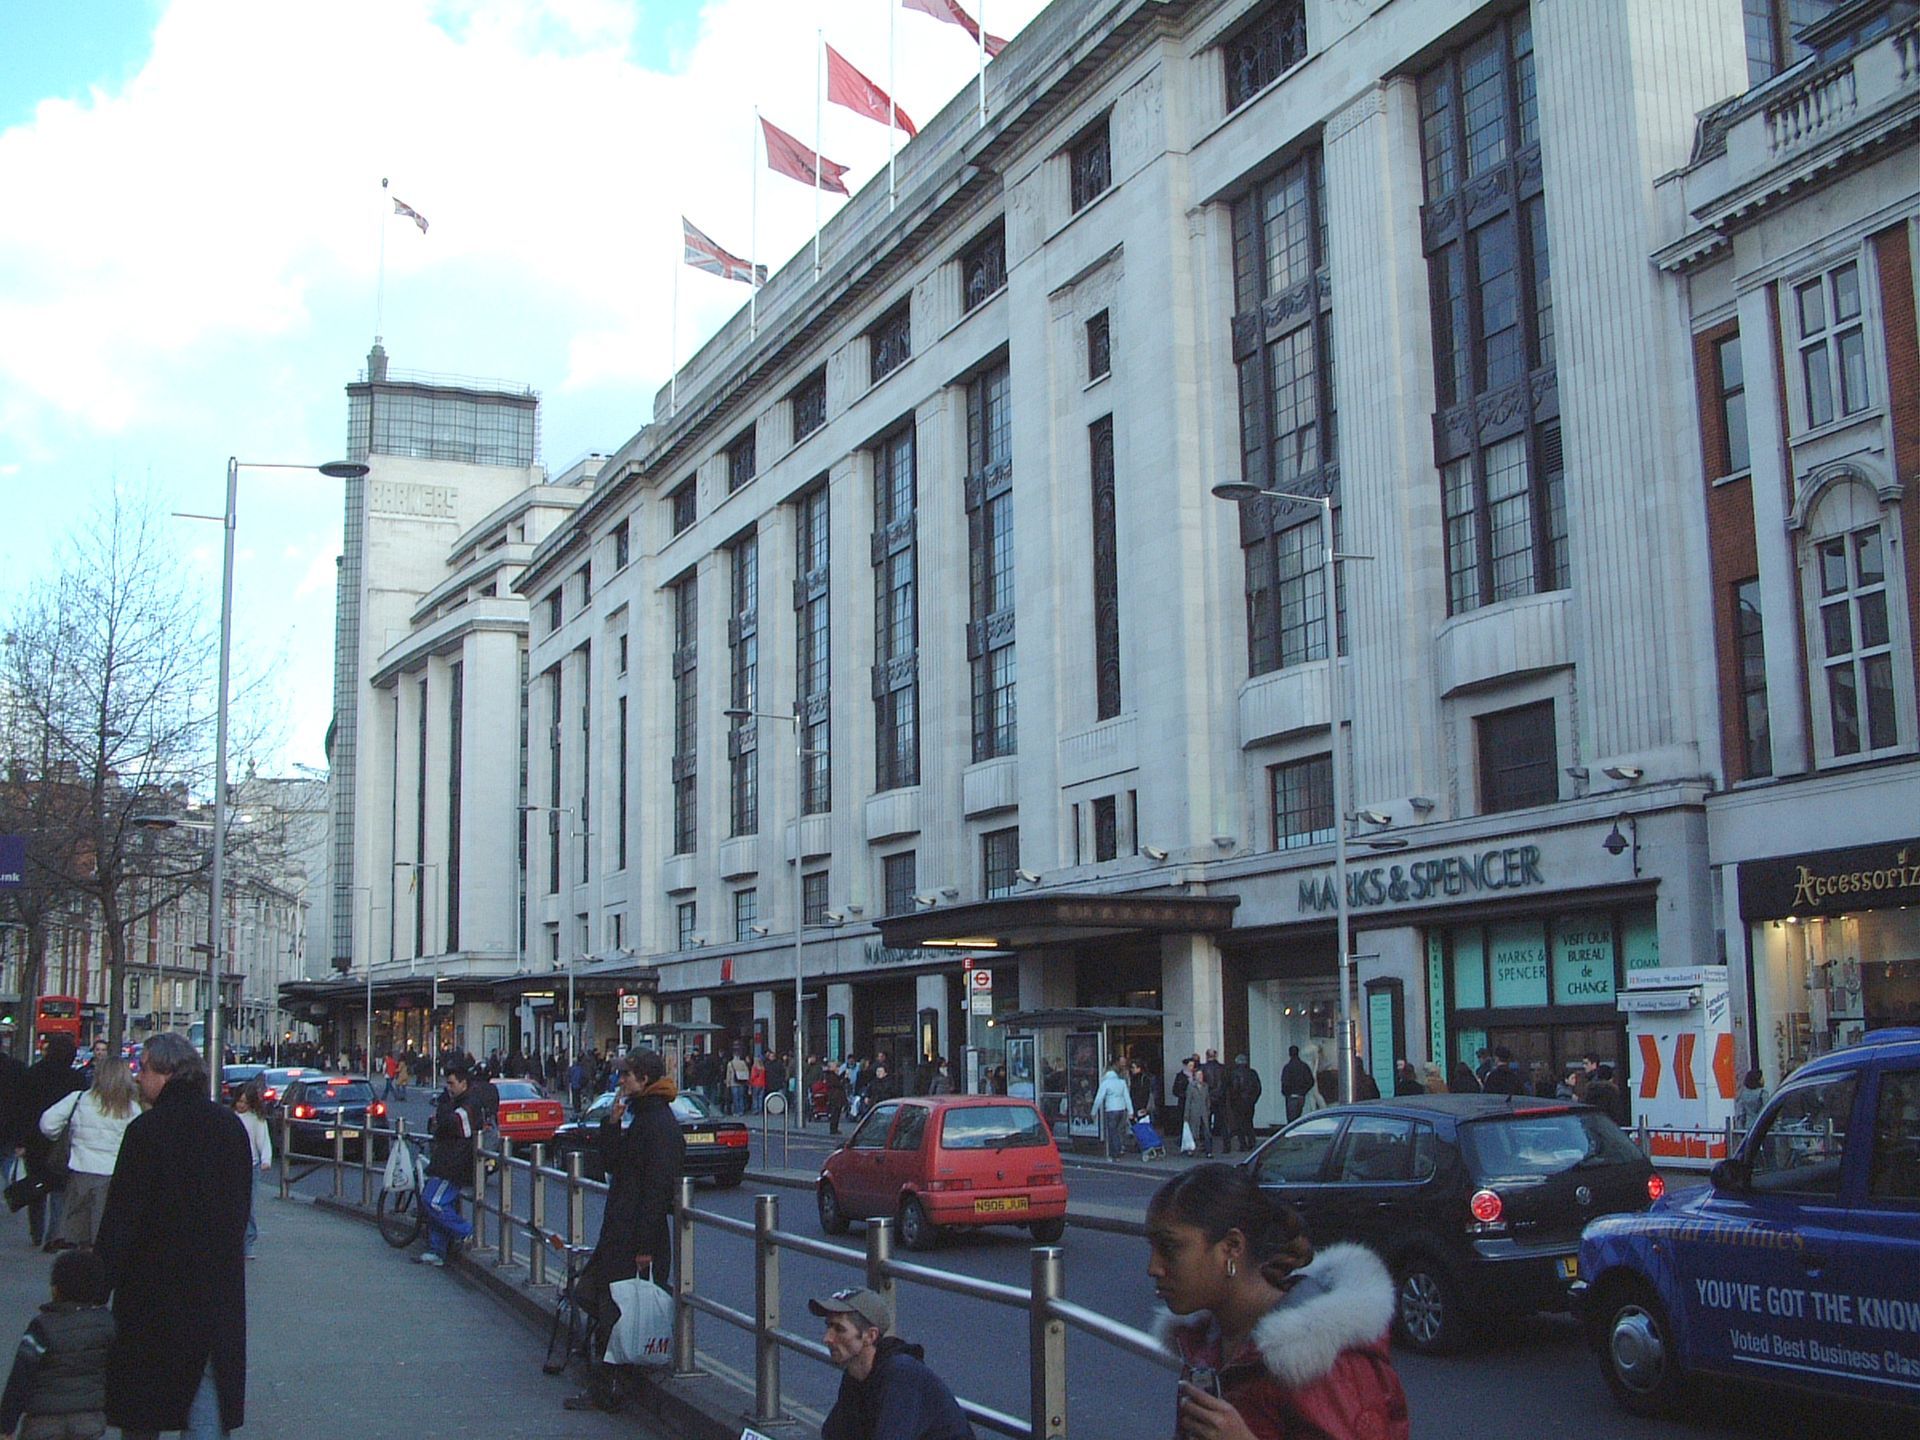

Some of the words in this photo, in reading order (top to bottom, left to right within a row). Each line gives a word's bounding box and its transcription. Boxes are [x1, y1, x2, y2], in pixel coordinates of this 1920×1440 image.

[1562, 934, 1584, 946] VISIT
[1587, 931, 1610, 944] OUR
[1498, 951, 1534, 964] MARKS
[1567, 949, 1605, 962] BUREAU
[964, 959, 971, 969] E
[1581, 966, 1593, 977] de
[1498, 965, 1546, 982] SPENCER
[1567, 980, 1609, 996] CHANGE
[1696, 1278, 1762, 1314] YOU'VE
[1766, 1286, 1805, 1318] GOT
[1810, 1291, 1853, 1325] THE
[1730, 1328, 1769, 1354] Voted
[1773, 1334, 1807, 1359] Best
[1810, 1340, 1880, 1371] Business
